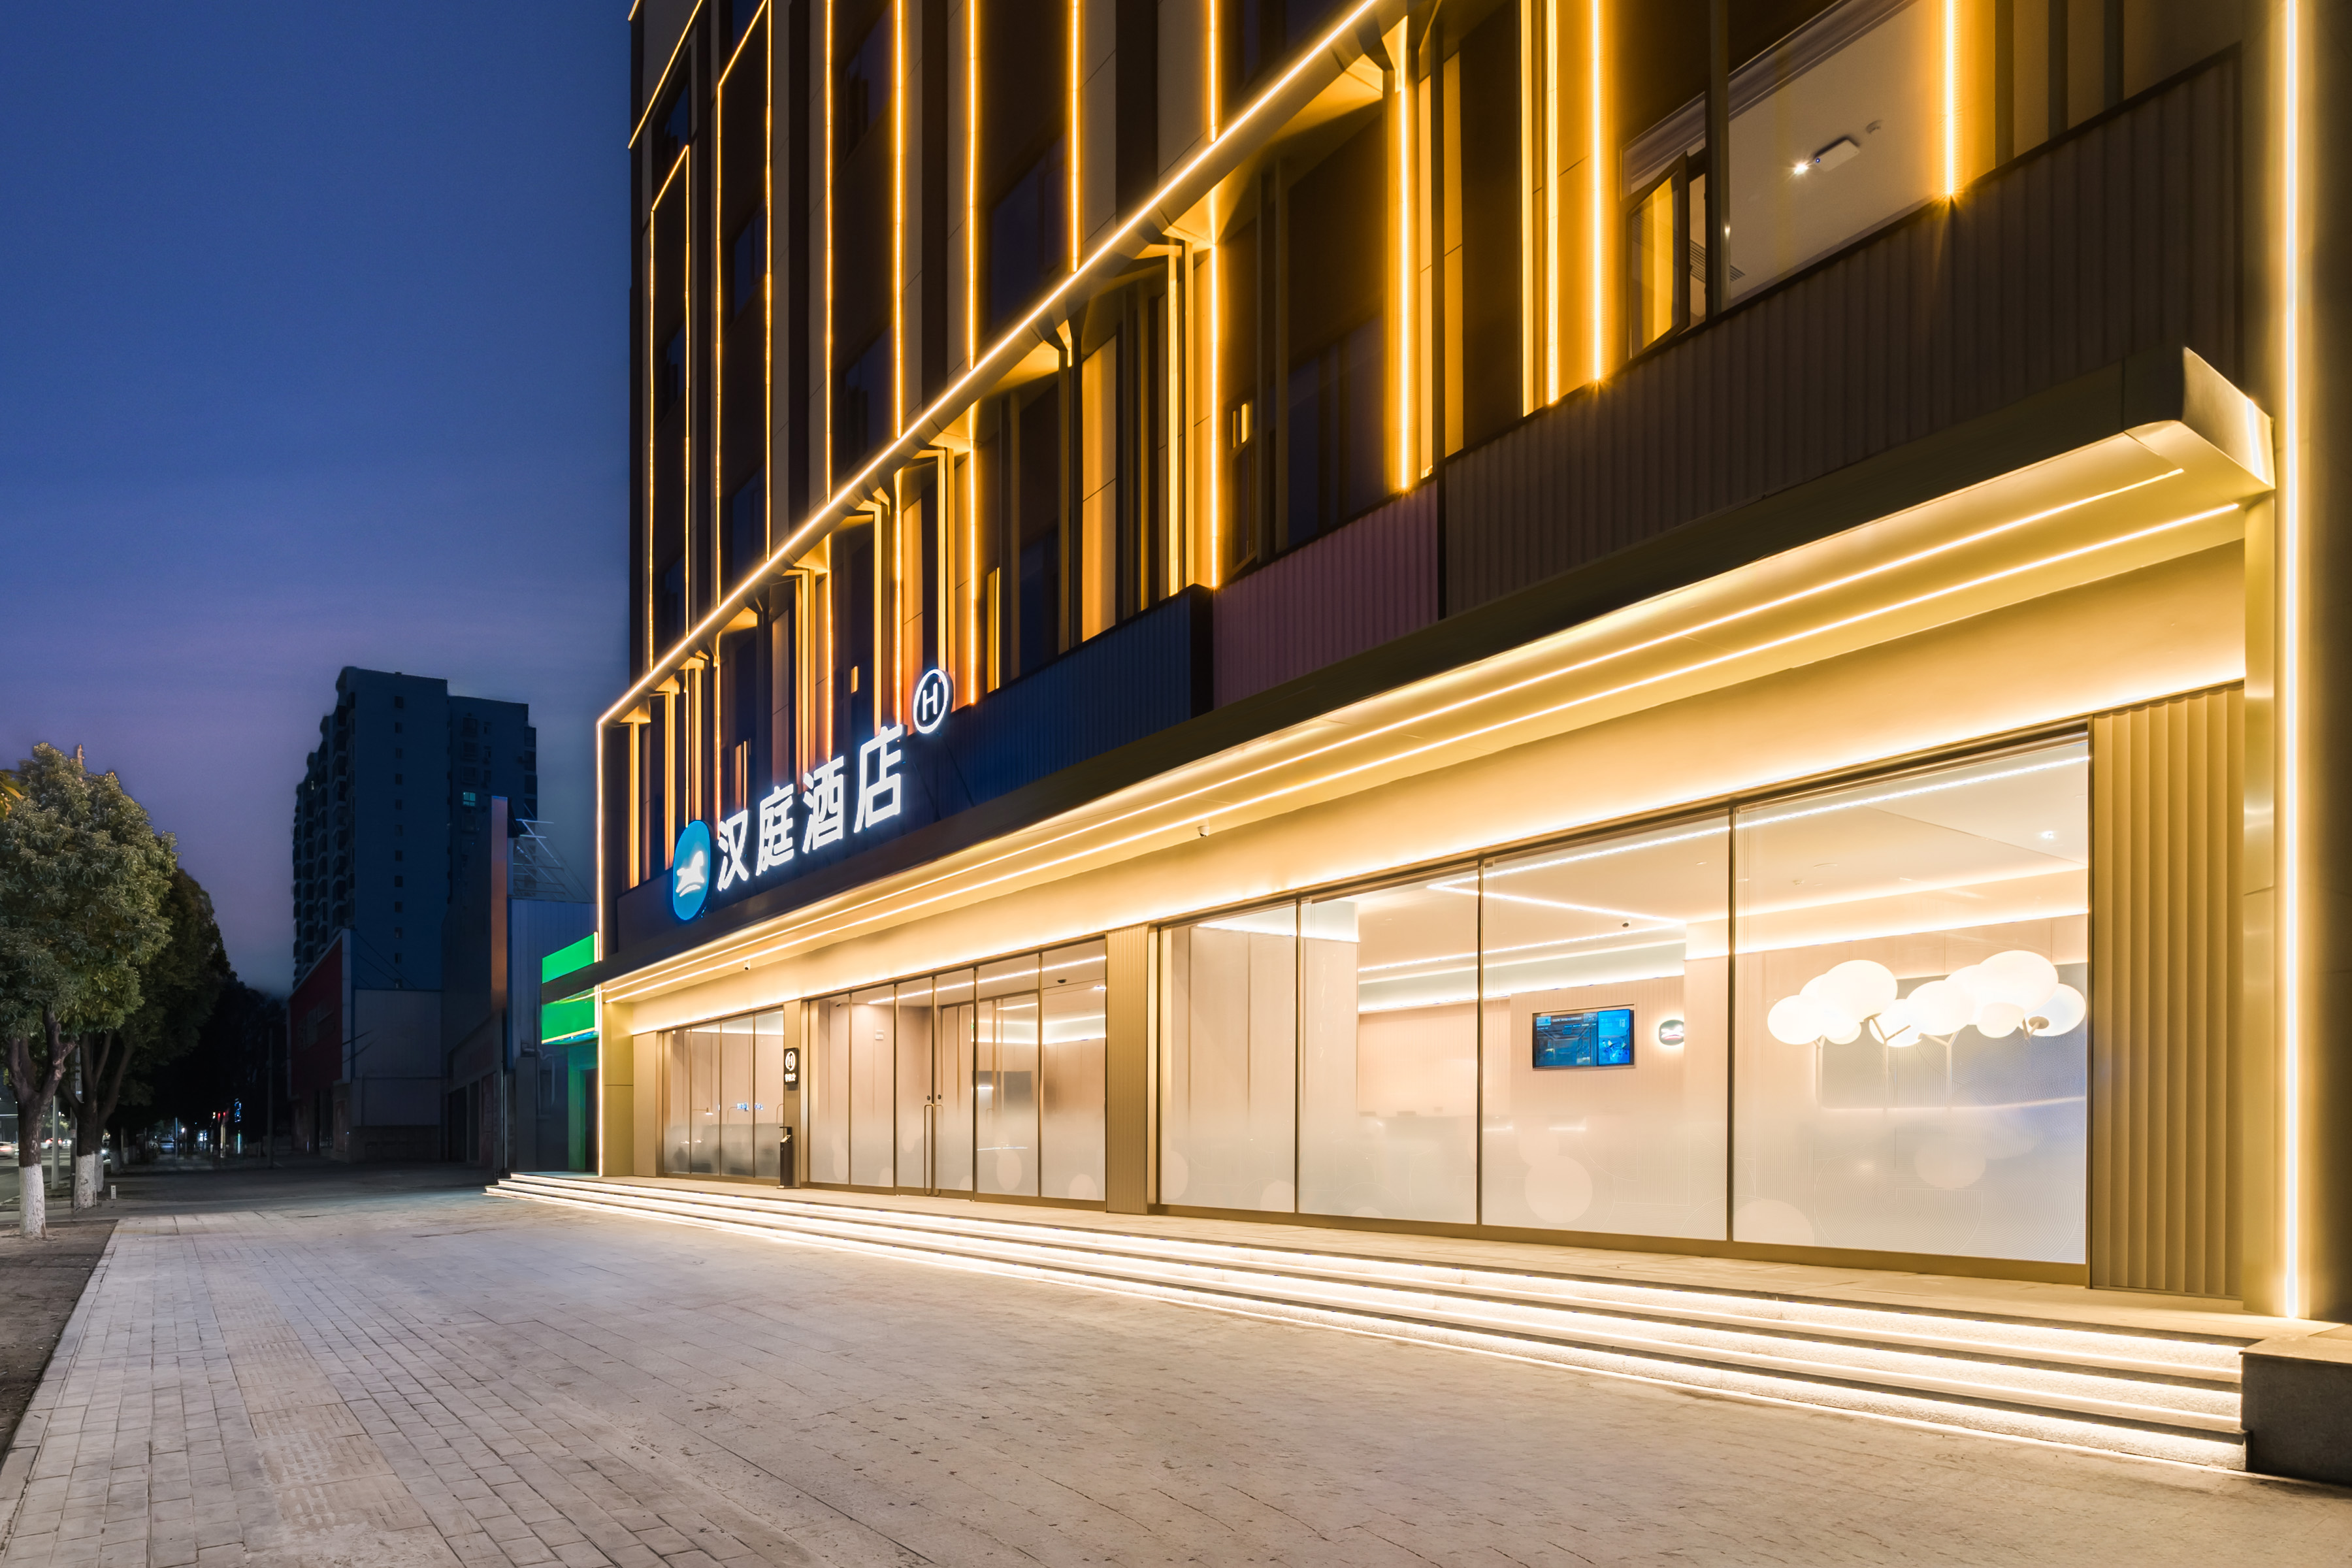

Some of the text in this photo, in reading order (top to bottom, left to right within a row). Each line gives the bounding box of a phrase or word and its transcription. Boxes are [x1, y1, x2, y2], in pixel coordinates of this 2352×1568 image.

[923, 683, 938, 721] H
[717, 724, 903, 891] 汉庭酒店
